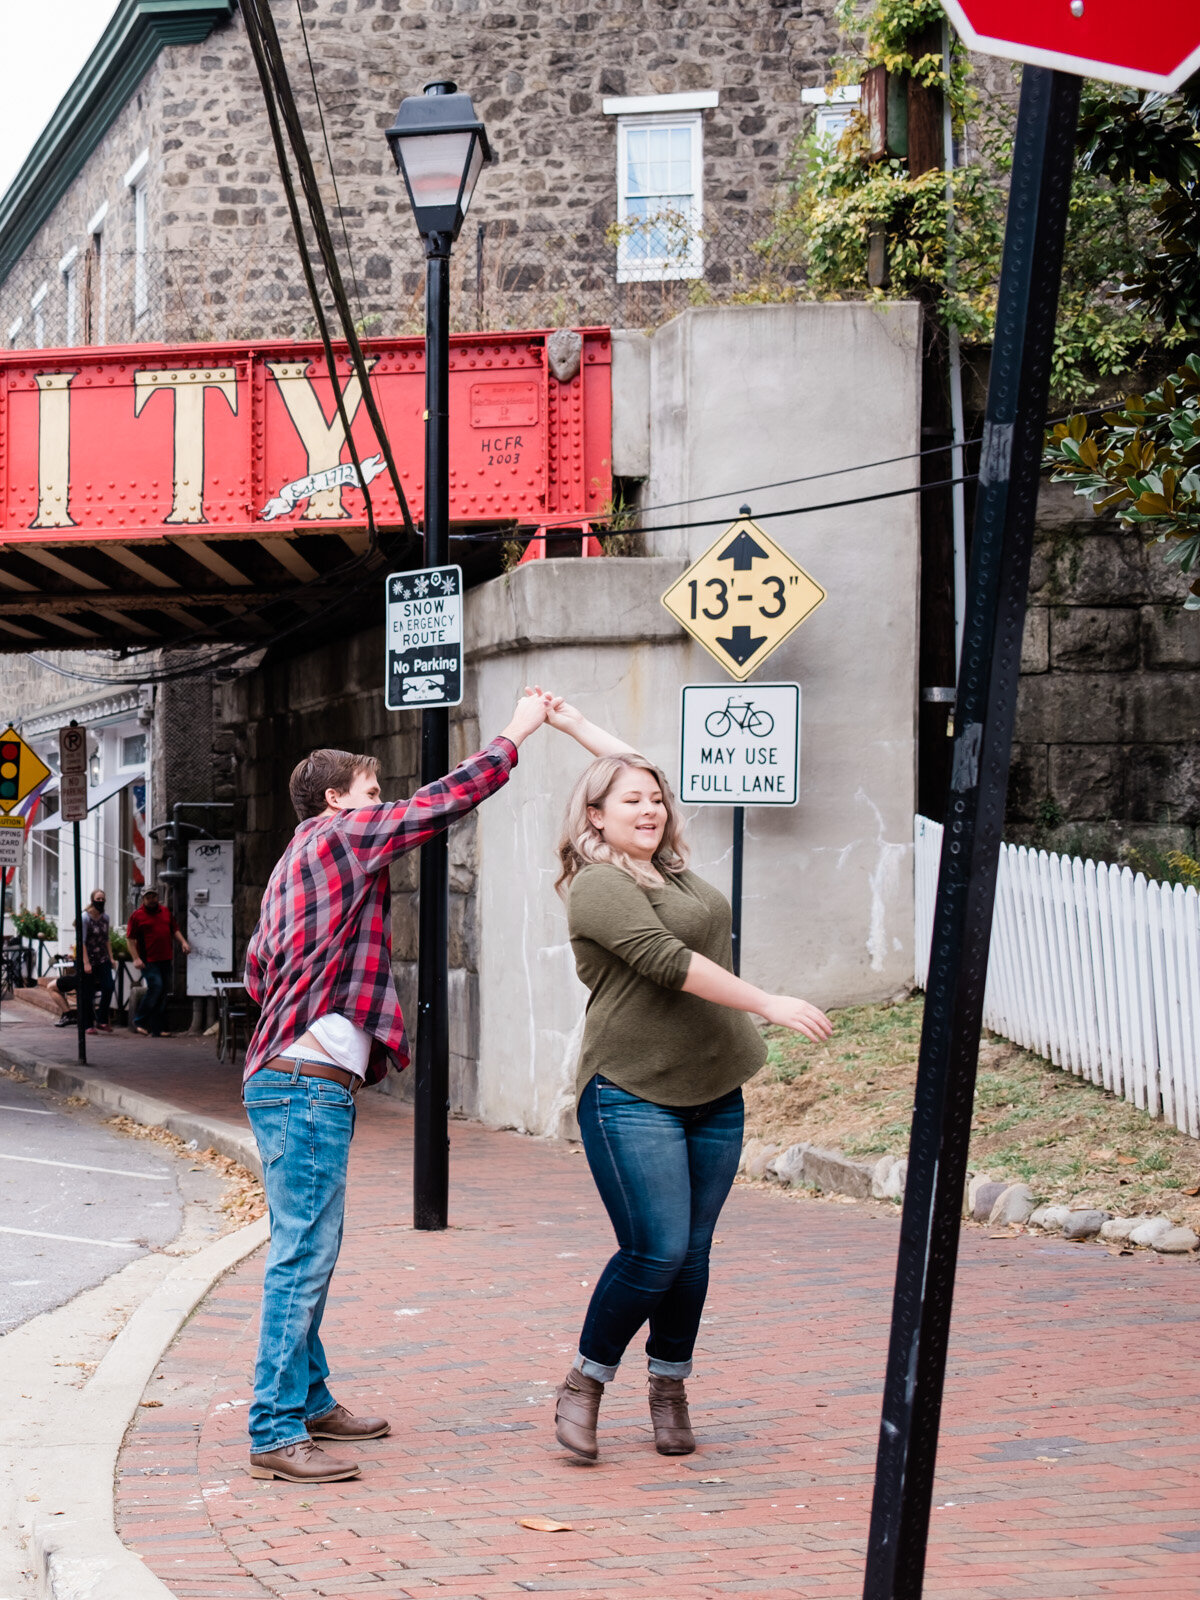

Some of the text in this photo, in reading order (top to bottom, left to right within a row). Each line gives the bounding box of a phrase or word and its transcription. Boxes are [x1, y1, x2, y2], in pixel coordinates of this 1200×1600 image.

[481, 435, 523, 452] HCFR
[488, 453, 520, 466] 2003
[325, 465, 355, 487] 1772
[403, 599, 445, 617] SNOW
[402, 630, 446, 647] ROUTE
[393, 656, 457, 675] No Parking
[701, 747, 778, 765] MAY USE
[690, 775, 785, 793] FULL LANE
